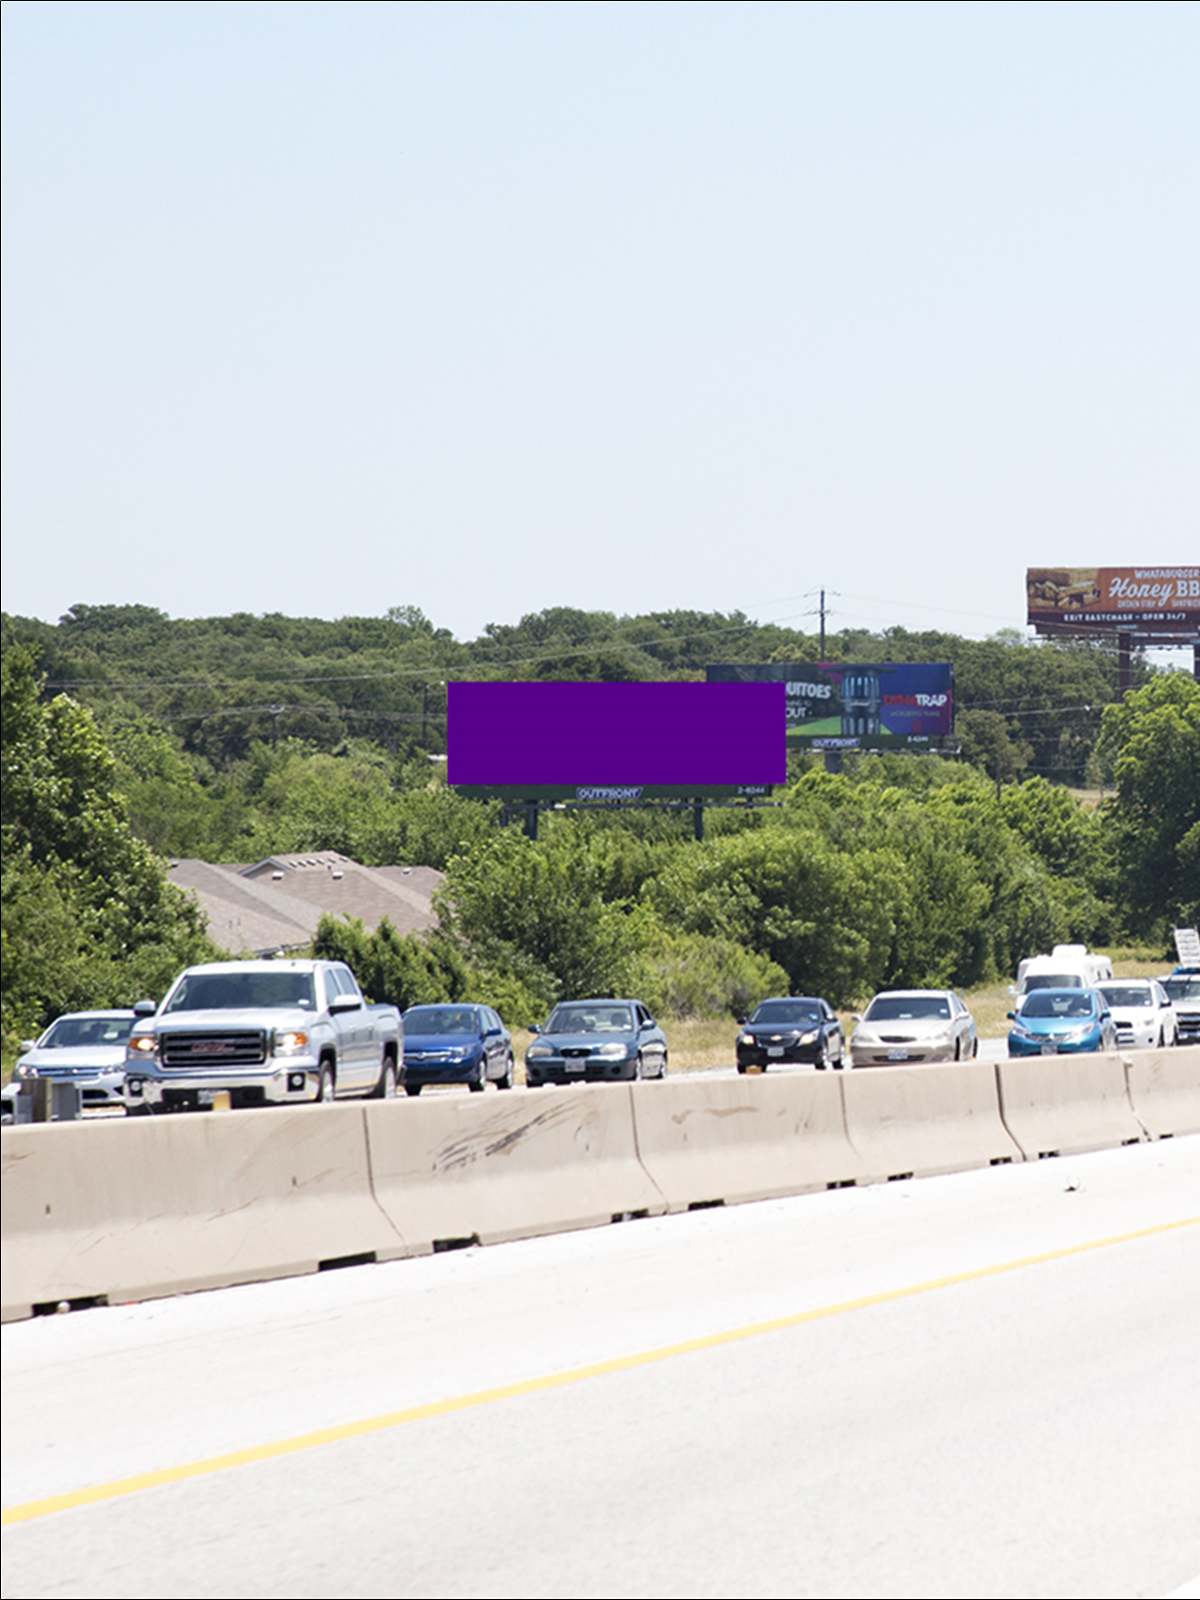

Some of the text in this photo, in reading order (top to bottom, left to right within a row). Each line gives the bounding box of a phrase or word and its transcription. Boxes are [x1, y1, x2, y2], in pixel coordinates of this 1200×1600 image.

[1109, 577, 1175, 607] Honey
[1085, 613, 1133, 621] EASTCHASE
[1142, 613, 1164, 621] OPEN
[1166, 613, 1187, 621] 24/7
[578, 788, 641, 799] OUTFRONT
